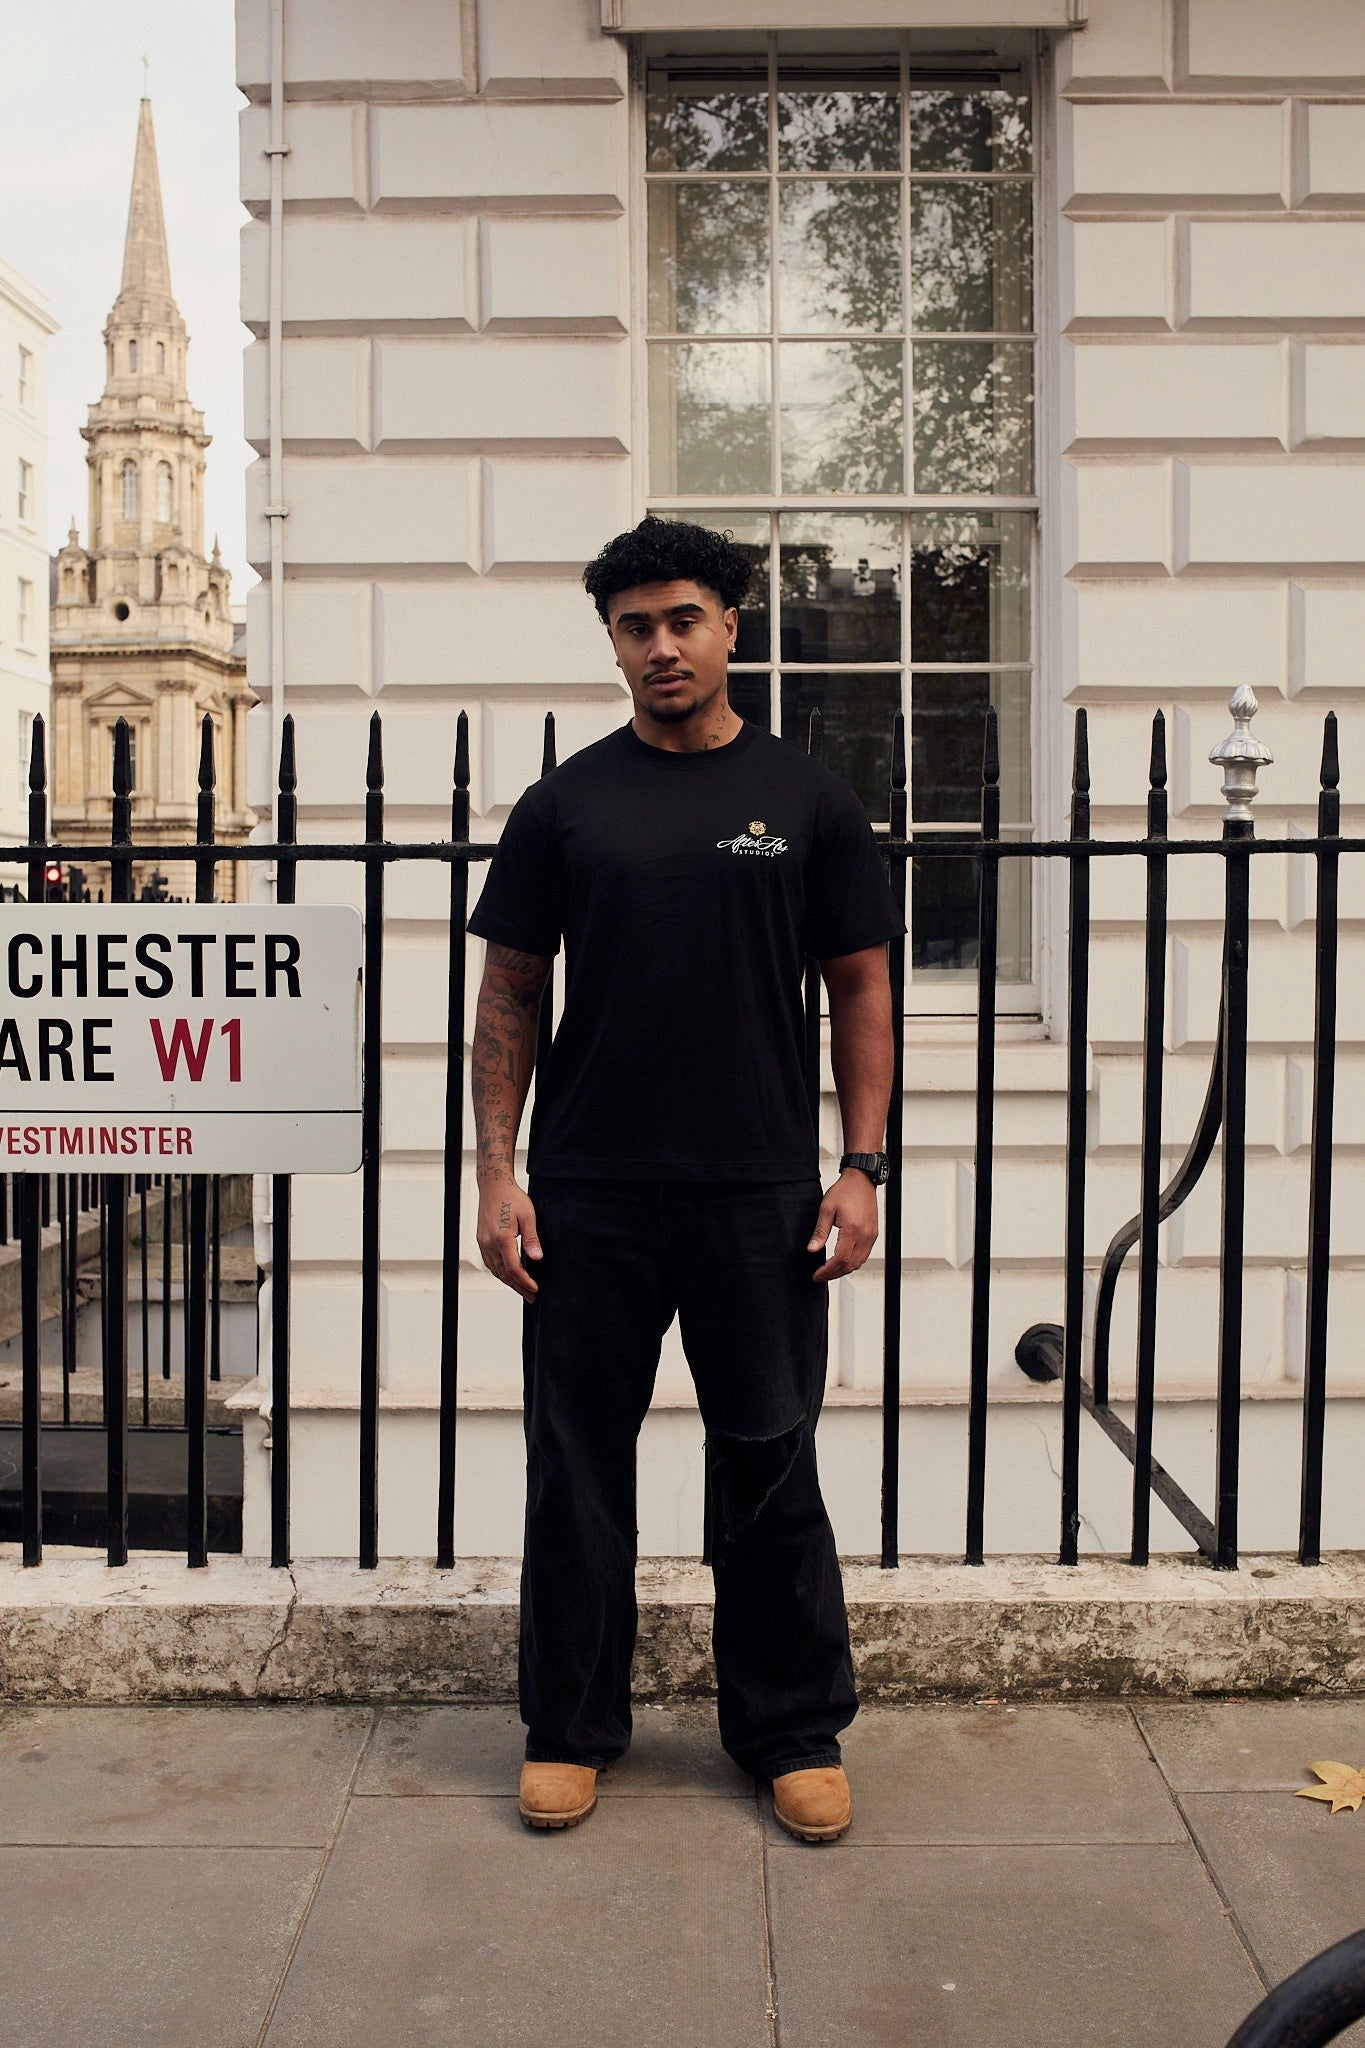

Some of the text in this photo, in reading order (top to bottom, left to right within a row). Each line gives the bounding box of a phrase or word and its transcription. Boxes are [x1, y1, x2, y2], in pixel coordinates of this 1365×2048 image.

[739, 849, 775, 858] STUDIOS
[7, 933, 302, 999] CHESTER
[0, 1018, 242, 1082] ARE W1
[0, 1126, 193, 1155] ESTMINSTER
